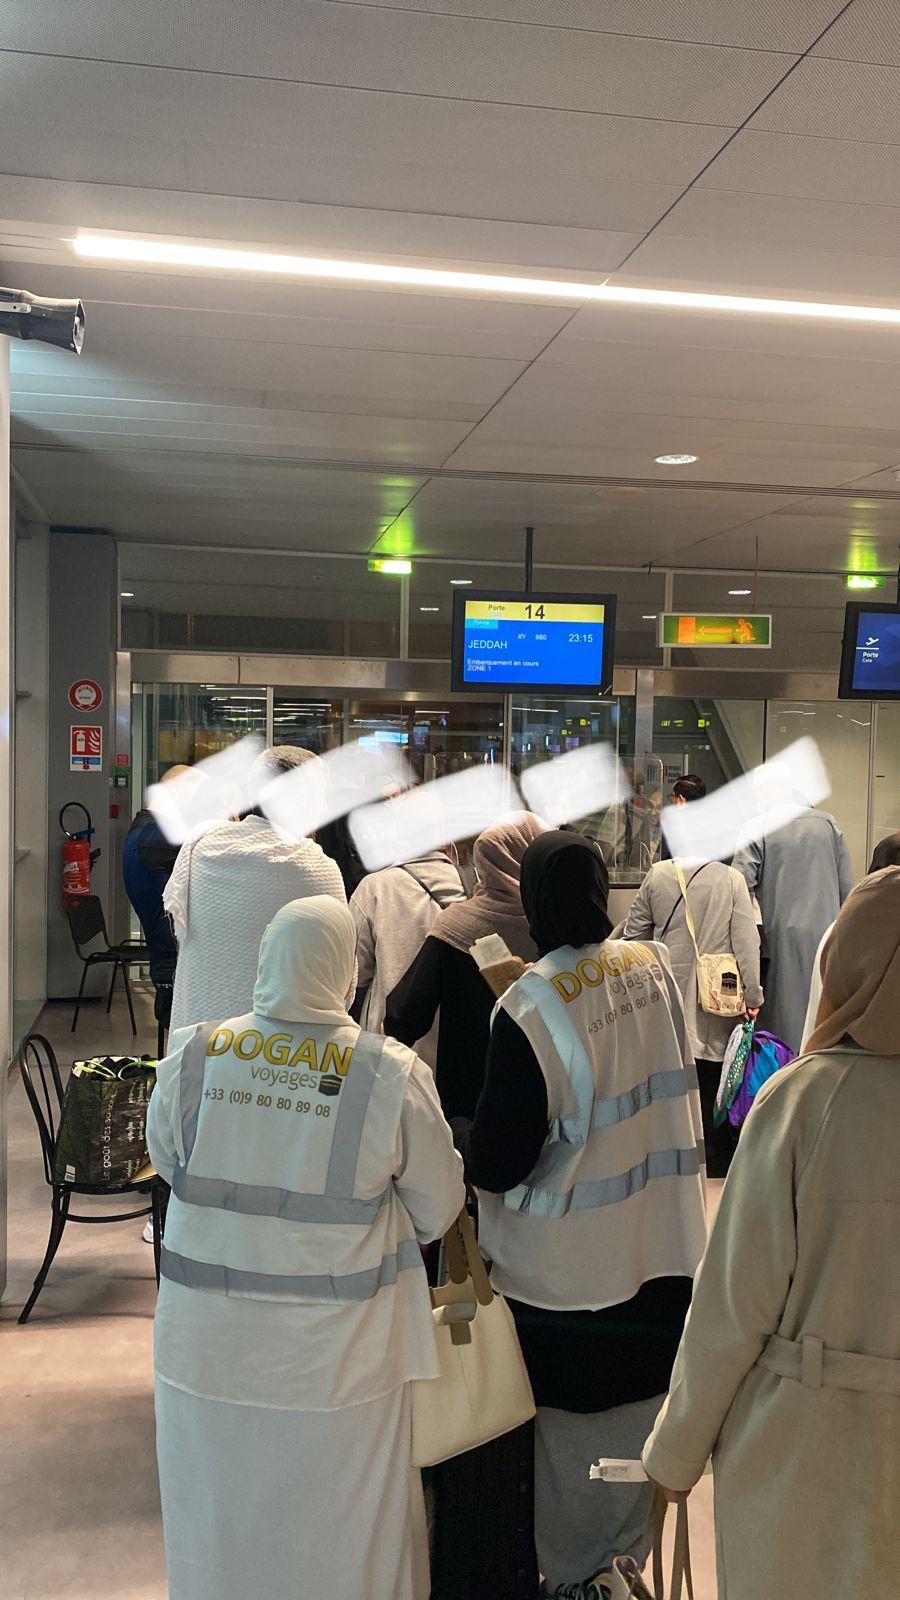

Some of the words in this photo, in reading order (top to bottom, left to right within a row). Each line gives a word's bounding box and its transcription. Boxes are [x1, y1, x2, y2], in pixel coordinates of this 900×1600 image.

[525, 604, 545, 619] 14
[467, 640, 508, 649] JEDDAH
[568, 633, 593, 643] 23:15
[467, 658, 513, 666] Embarquement
[467, 664, 486, 672] ZONE
[551, 943, 657, 1004] DOGAN
[588, 1018, 604, 1035] +33
[620, 1002, 633, 1015] 80
[635, 996, 647, 1009] 80
[206, 1028, 354, 1077] DOGAN
[250, 1065, 319, 1090] voyages
[204, 1087, 224, 1101] +33
[229, 1089, 252, 1105] (0)9
[256, 1094, 272, 1107] 80
[276, 1097, 292, 1111] 80
[295, 1100, 311, 1114] 89
[315, 1104, 331, 1118] 08
[101, 1125, 111, 1143] des
